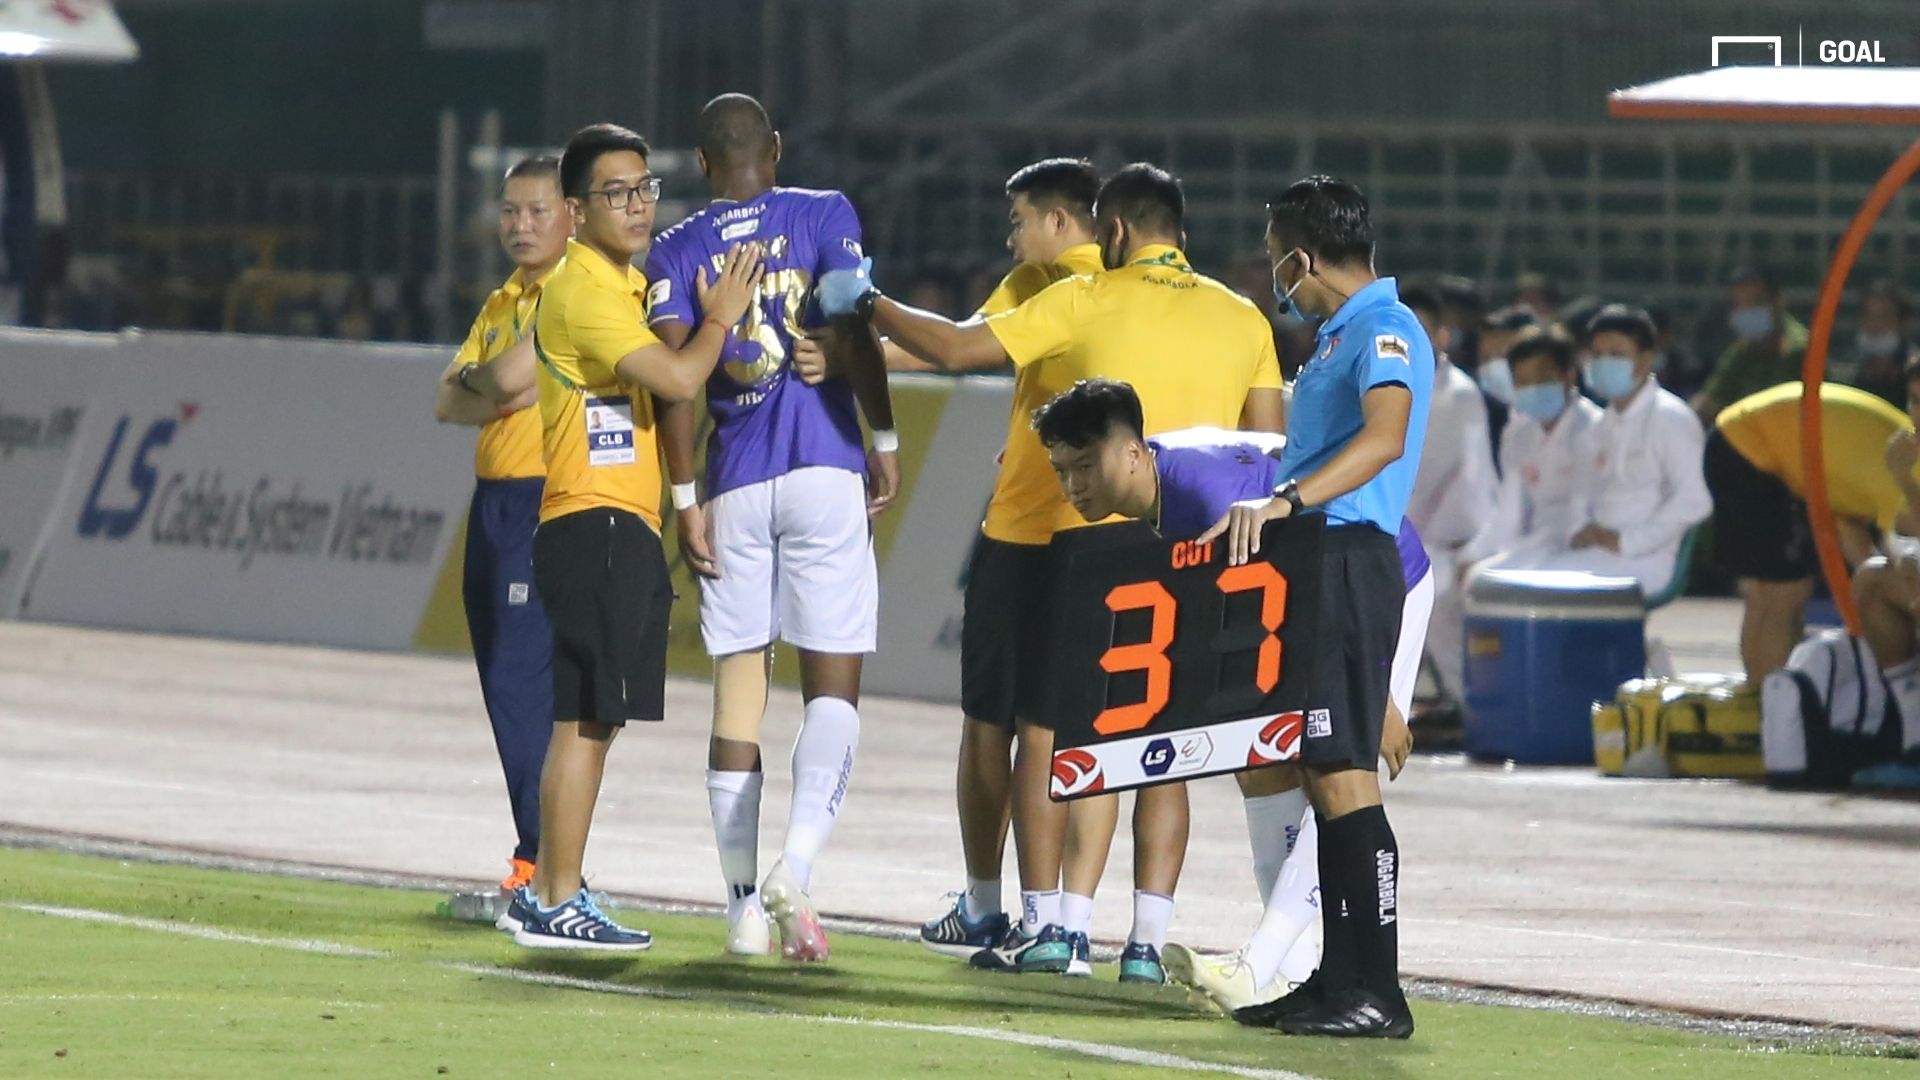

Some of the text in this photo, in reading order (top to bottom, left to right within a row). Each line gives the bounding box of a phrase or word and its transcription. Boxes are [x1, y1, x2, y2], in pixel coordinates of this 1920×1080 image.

[598, 433, 624, 446] CLB
[77, 414, 178, 540] LS
[1171, 540, 1215, 570] OUT
[1093, 561, 1288, 735] 37
[1145, 749, 1167, 766] LS
[1376, 849, 1396, 926] JOGARBOLA
